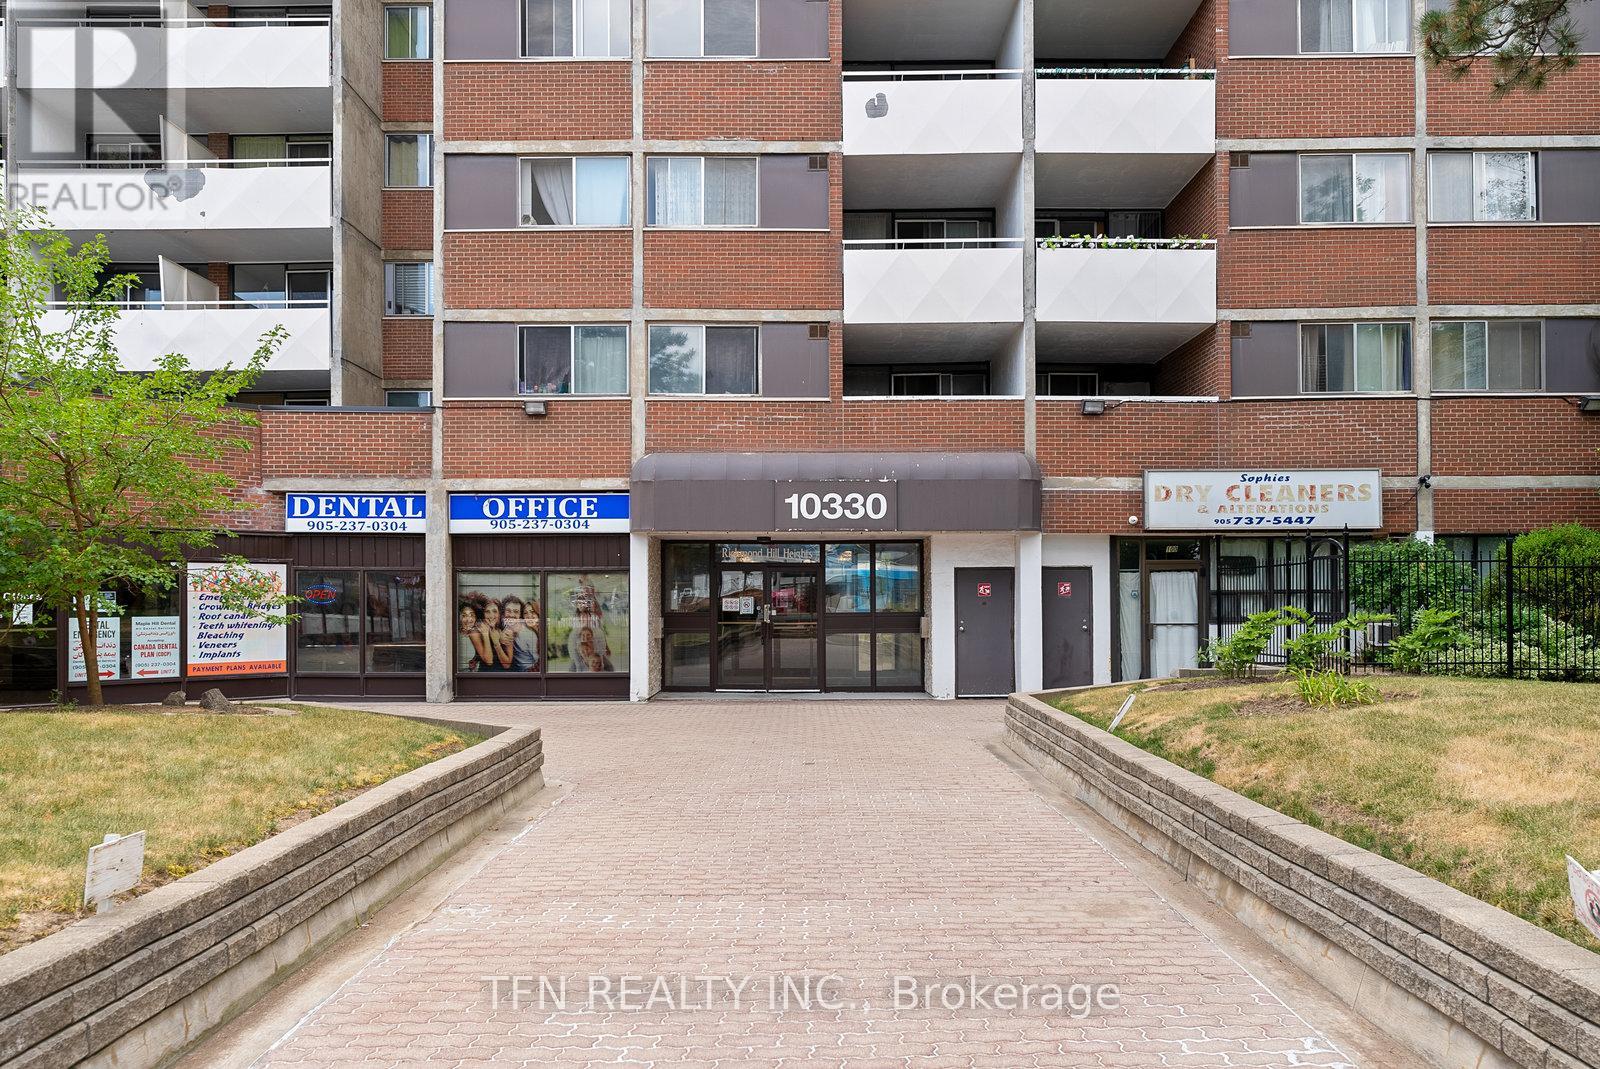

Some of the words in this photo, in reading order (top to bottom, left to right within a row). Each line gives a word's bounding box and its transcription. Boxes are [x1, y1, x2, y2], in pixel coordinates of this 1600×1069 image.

[1240, 474, 1290, 483] Sophies
[1154, 485, 1213, 502] DRY
[1225, 484, 1372, 502] CLEANERS
[292, 496, 423, 518] DENTAL
[482, 497, 598, 518] OFFICE
[784, 493, 888, 519] 10330
[1197, 505, 1208, 514] &
[1217, 505, 1329, 514] ALTERATIONS
[490, 520, 590, 529] 905-237-0304
[1233, 516, 1316, 525] 737-5447
[307, 521, 408, 531] 905-237-0304
[722, 547, 762, 558] Richmond
[766, 548, 780, 559] Hill
[783, 548, 813, 560] Heights
[304, 589, 336, 599] OPEN
[199, 612, 221, 620] Root
[198, 622, 224, 630] Teeth
[197, 632, 245, 640] Bleaching
[199, 651, 241, 660] Implants
[249, 663, 282, 671] AVAILABLE
